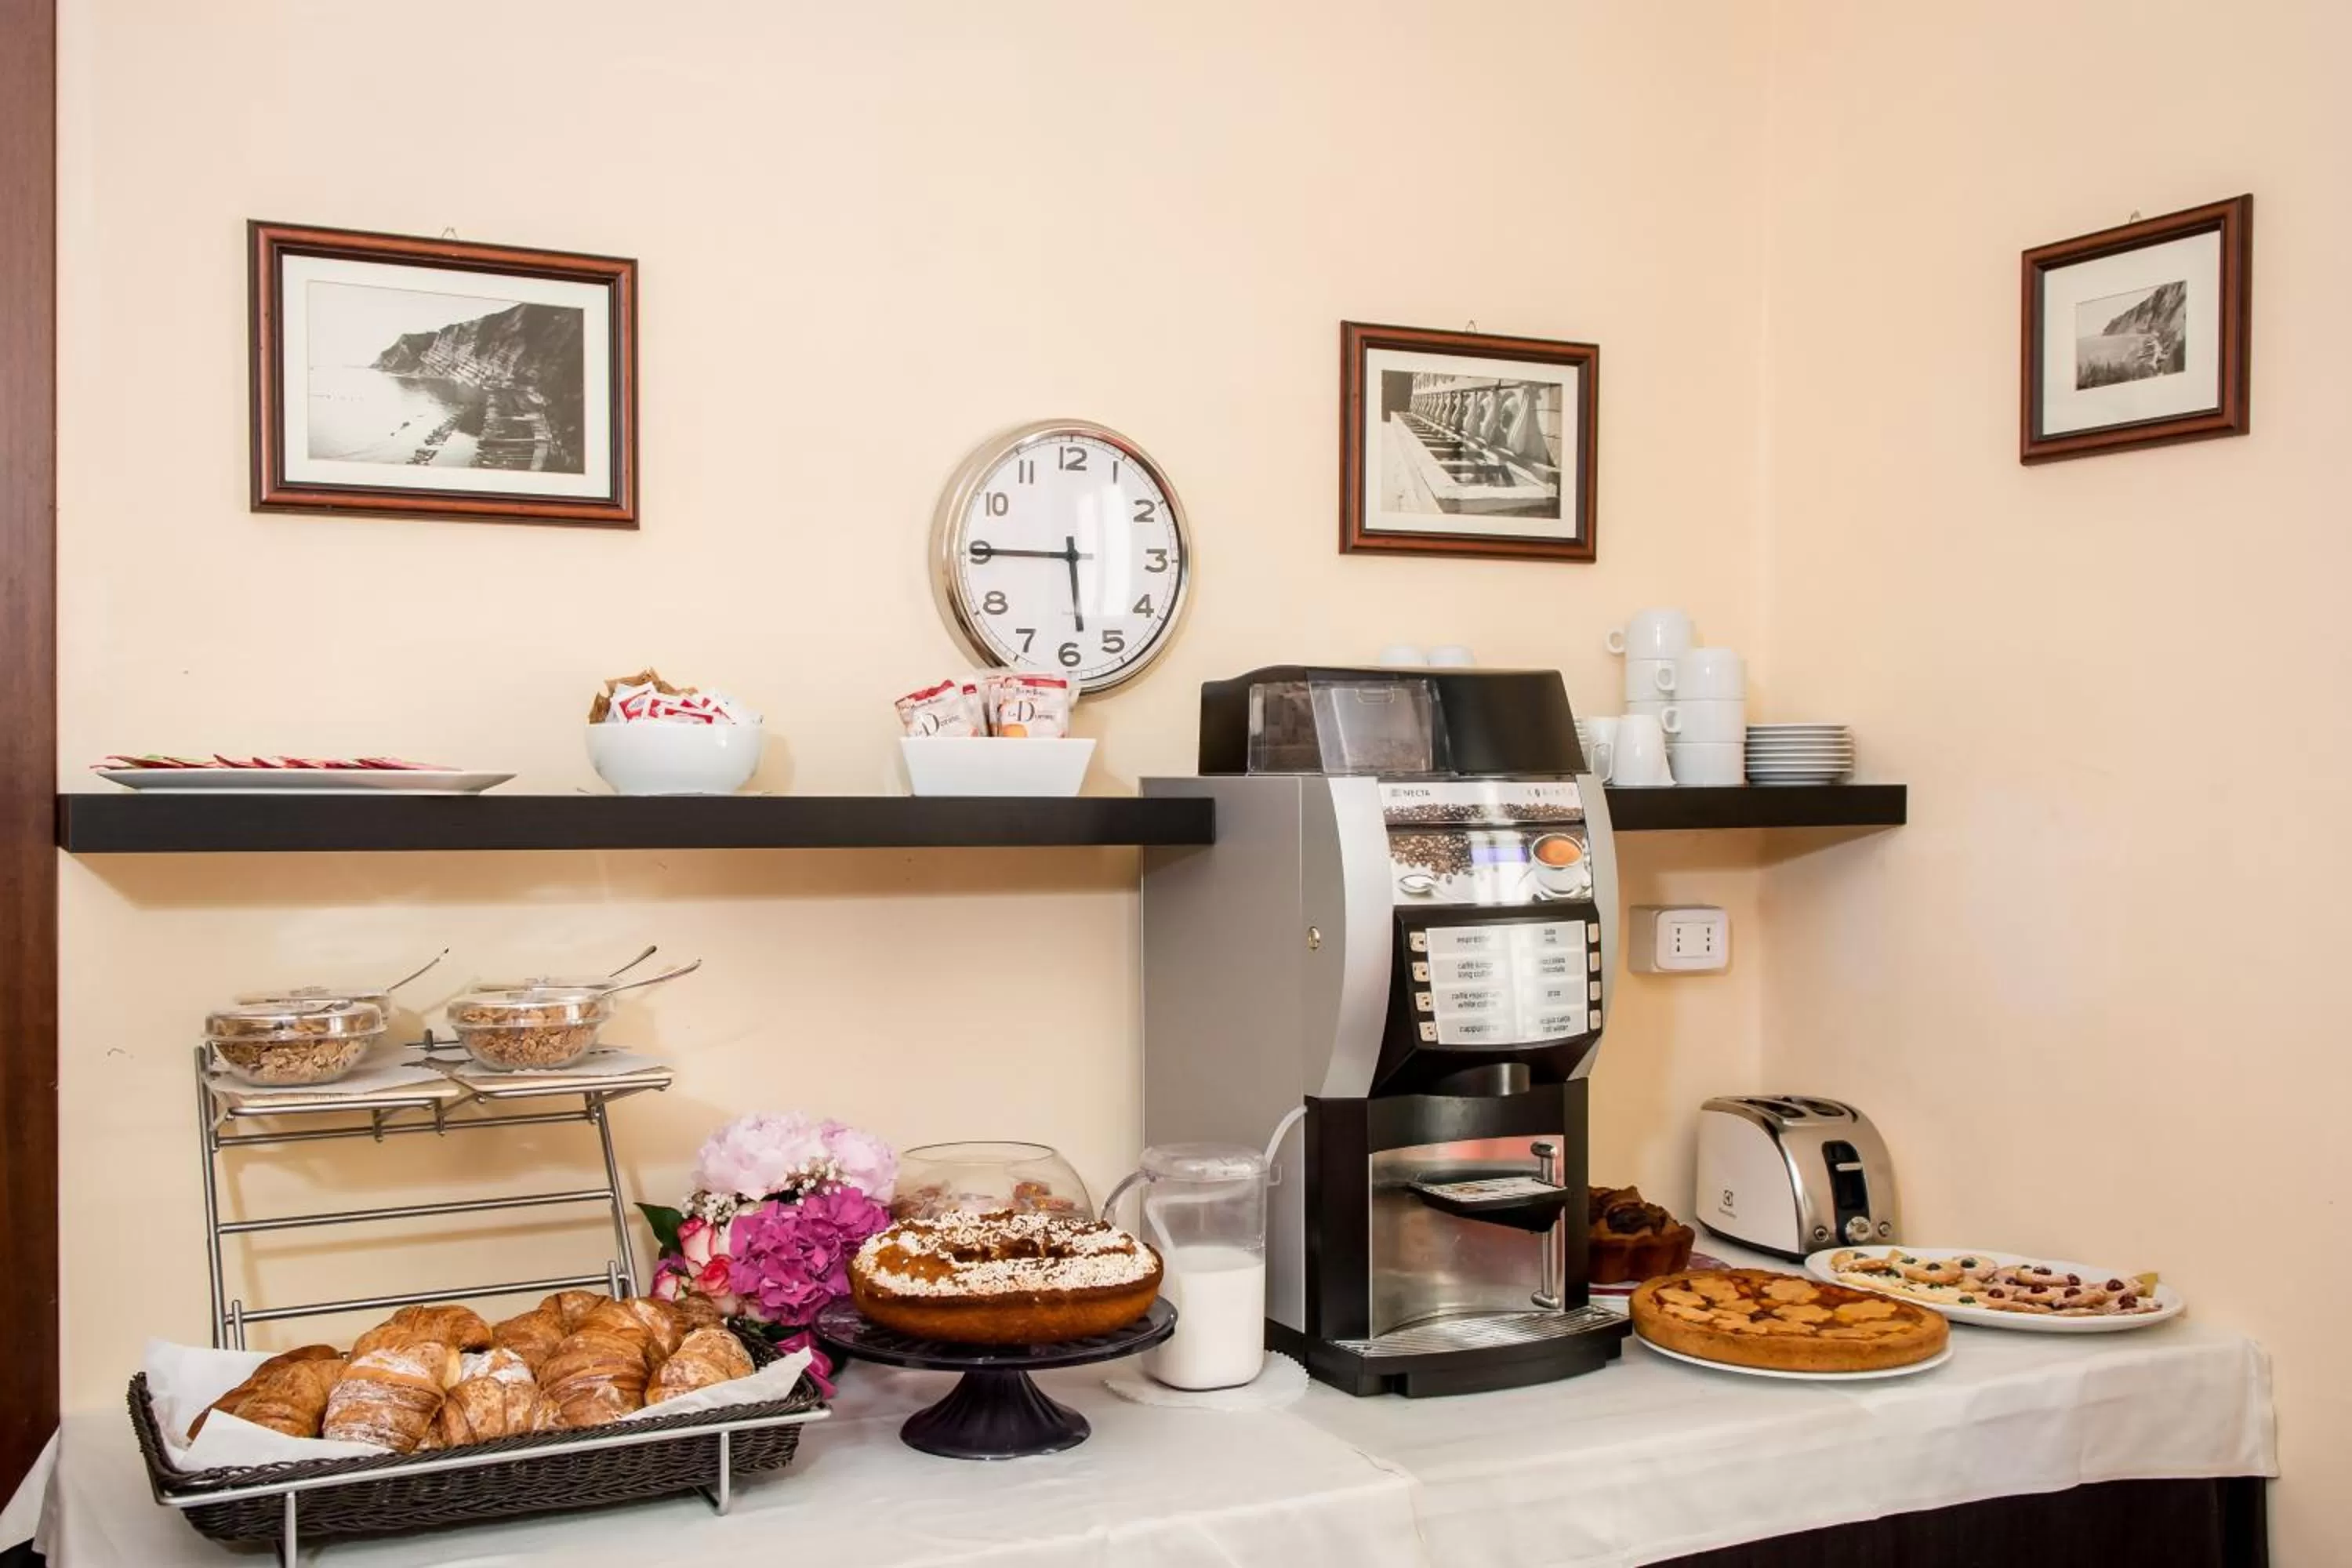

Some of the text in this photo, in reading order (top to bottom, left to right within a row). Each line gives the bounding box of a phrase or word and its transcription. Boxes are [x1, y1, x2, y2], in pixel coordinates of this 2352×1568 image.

[1059, 446, 1087, 471] 12
[1018, 459, 1034, 484] 11
[1112, 460, 1119, 484] 1
[985, 492, 1009, 517] 10
[1134, 499, 1156, 523] 2
[970, 539, 992, 564] 9
[1144, 548, 1168, 573] 3
[982, 590, 1009, 615] 8
[1132, 593, 1155, 618] 4
[1015, 628, 1036, 653] 7
[1102, 630, 1125, 654] 5
[1058, 642, 1081, 666] 6
